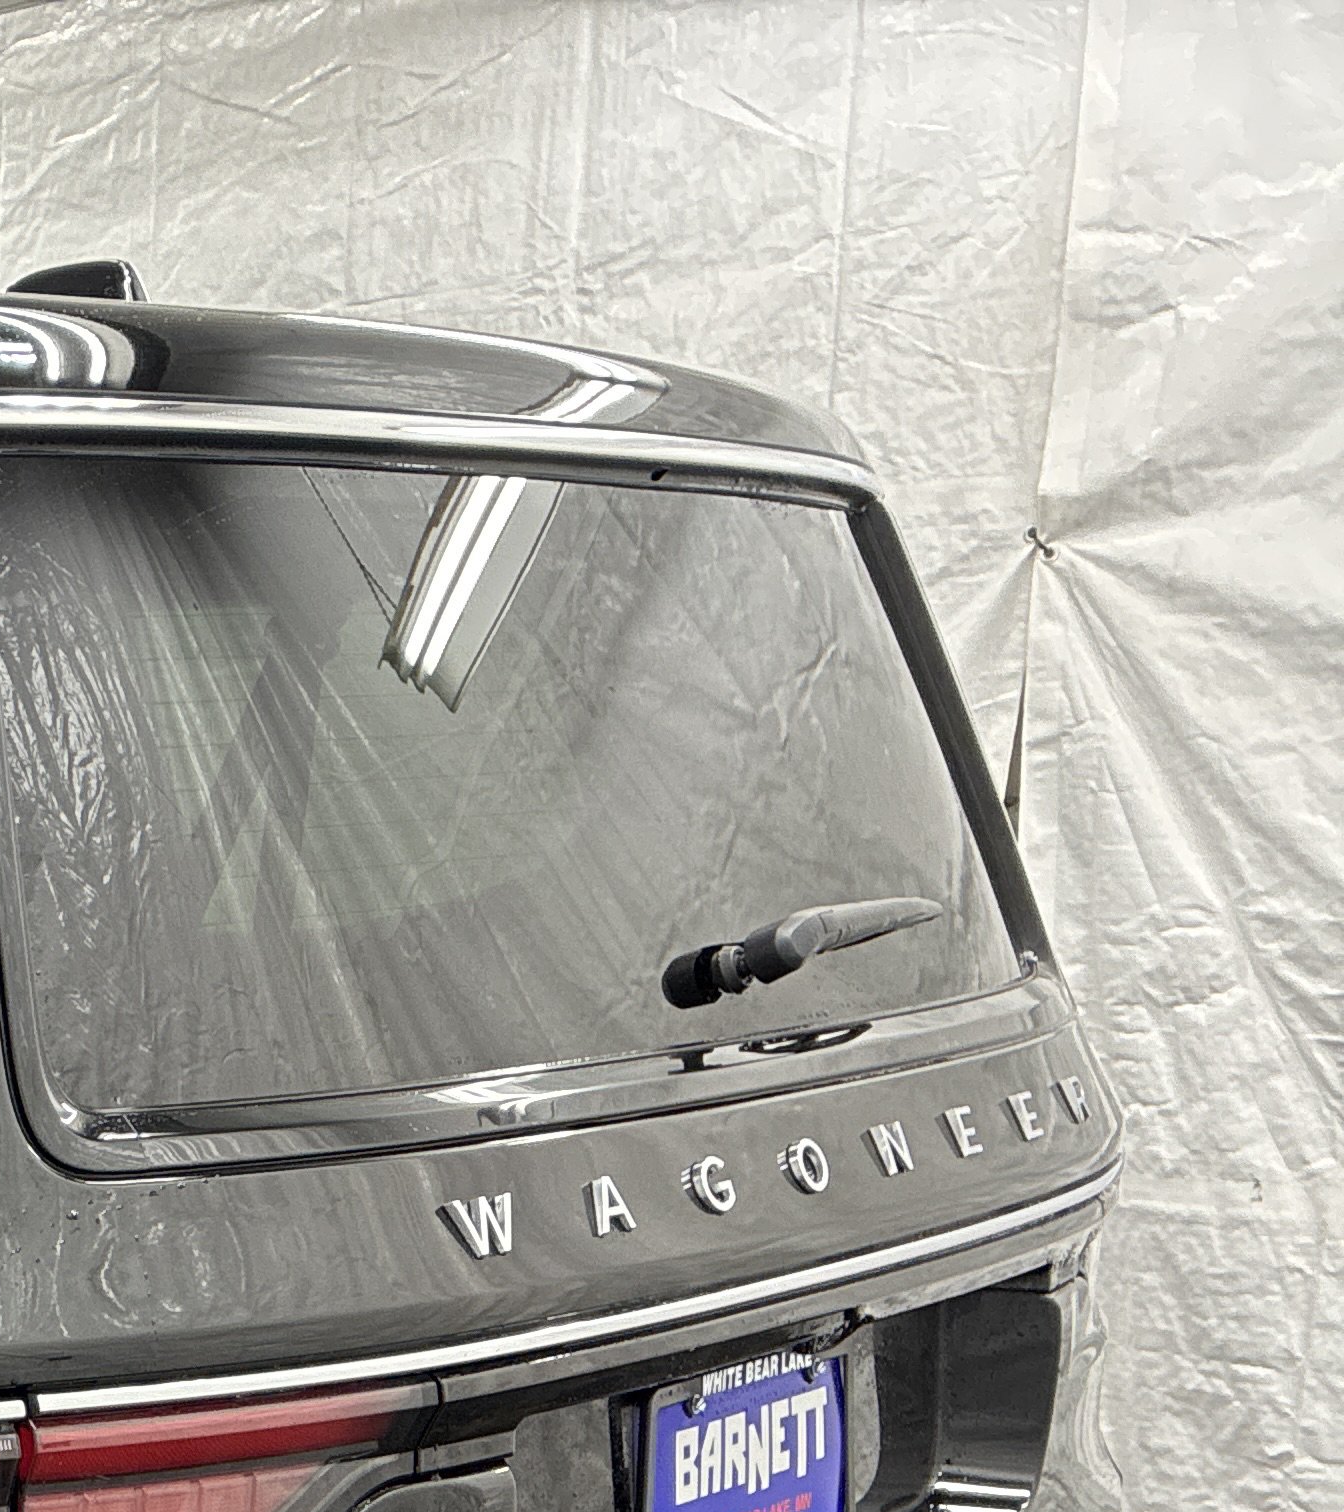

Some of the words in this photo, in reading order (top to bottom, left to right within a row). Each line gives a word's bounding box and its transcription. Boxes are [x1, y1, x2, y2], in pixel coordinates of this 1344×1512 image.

[440, 1076, 1092, 1258] WAGONEER
[703, 1364, 743, 1397] WHITE
[745, 1355, 779, 1385] BEAR
[781, 1352, 813, 1373] LAKE
[675, 1386, 828, 1506] BARNETT
[795, 1492, 812, 1512] MN
